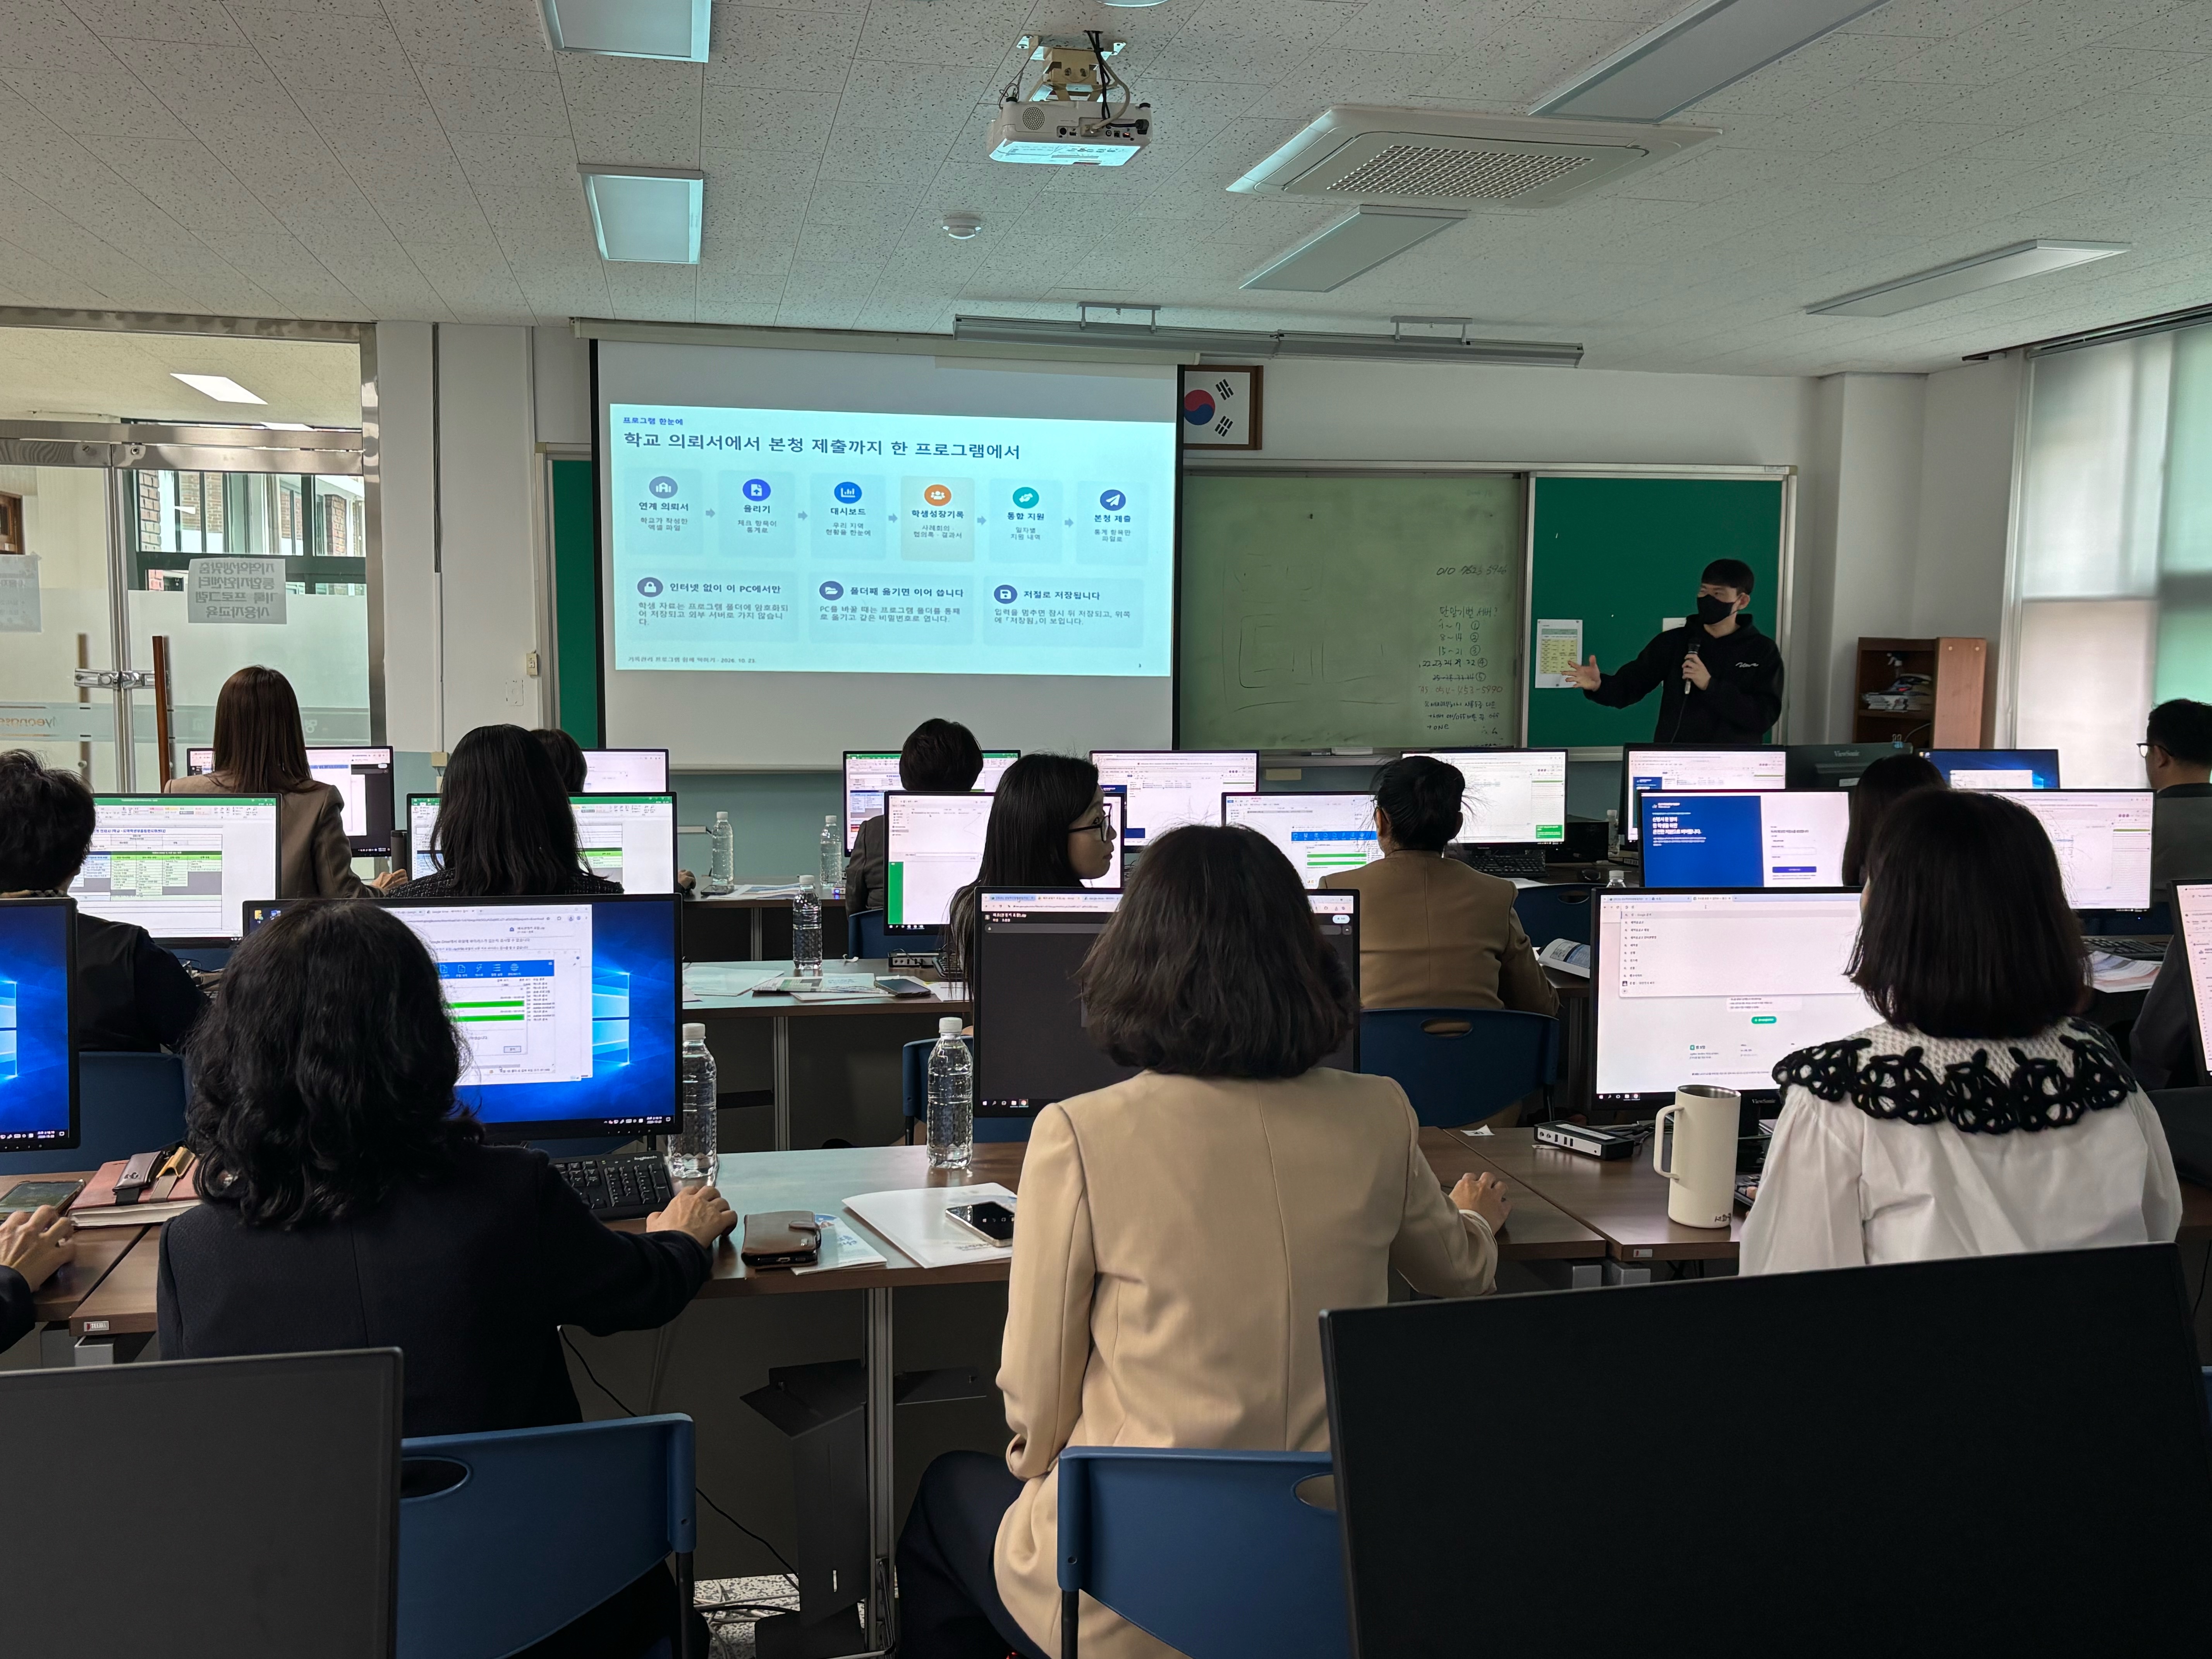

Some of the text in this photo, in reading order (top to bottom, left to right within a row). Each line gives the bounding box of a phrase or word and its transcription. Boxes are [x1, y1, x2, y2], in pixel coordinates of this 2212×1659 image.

[624, 432, 1019, 460] 학교 의뢰서에서 본청 제출까지 한 프로그램에서
[639, 502, 689, 511] 연계 의뢰서
[744, 505, 770, 514] 올리기
[830, 507, 866, 516] 대시보드
[912, 510, 964, 519] 학생성장기록
[1007, 512, 1024, 520] 통합
[641, 517, 688, 526] 학교가 작성한
[1094, 514, 1111, 522] 본청
[833, 522, 847, 530] 우리
[670, 583, 781, 594] 인터넷 없이 이 PC에서만
[850, 587, 963, 598] 폴더째 옮기면 이어 씁니다
[1024, 591, 1100, 600] 저절로 저장됩니다
[639, 602, 655, 610] 학생
[659, 602, 685, 610] 자료는
[754, 604, 788, 612] 암호화되
[757, 612, 783, 620] 않습니
[994, 608, 1018, 618] 입력을
[1079, 610, 1112, 618] 저장되고,
[860, 614, 876, 622] 같은
[923, 615, 950, 623] 엽니다.
[1049, 617, 1084, 625] 보입니다.
